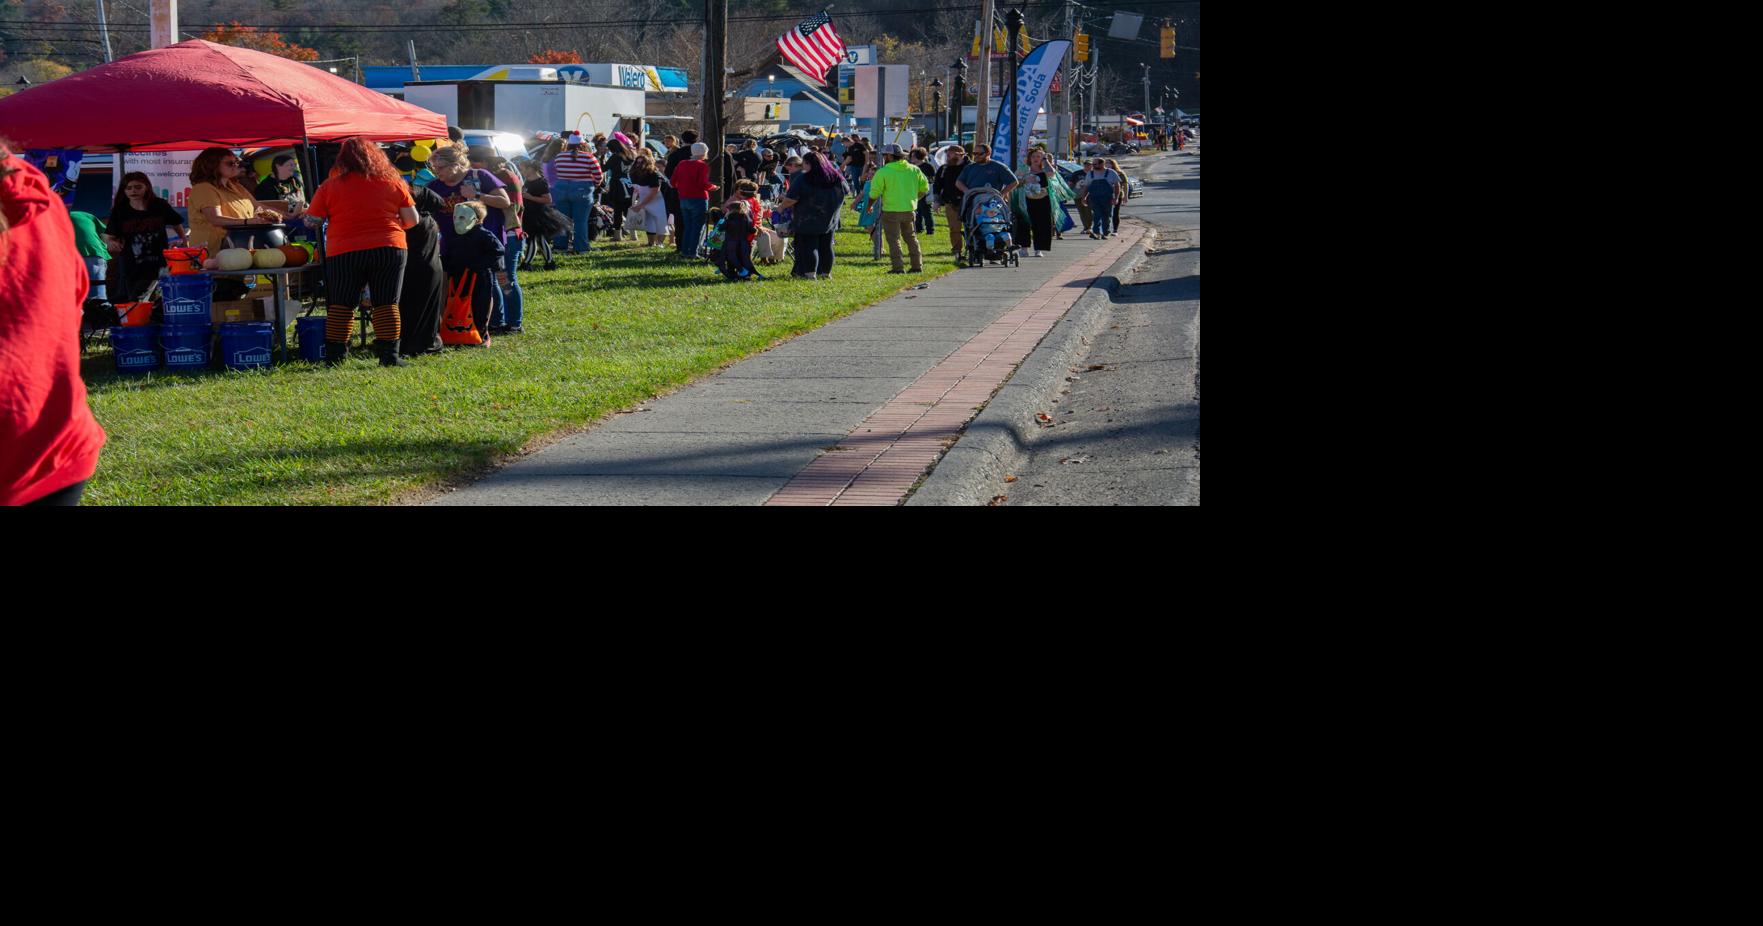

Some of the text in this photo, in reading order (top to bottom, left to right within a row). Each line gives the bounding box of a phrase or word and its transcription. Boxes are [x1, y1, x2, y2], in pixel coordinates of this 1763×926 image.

[618, 65, 645, 88] Valero
[1025, 73, 1047, 104] Soda
[165, 304, 201, 313] LOWE'S
[167, 353, 202, 363] LOWE'S
